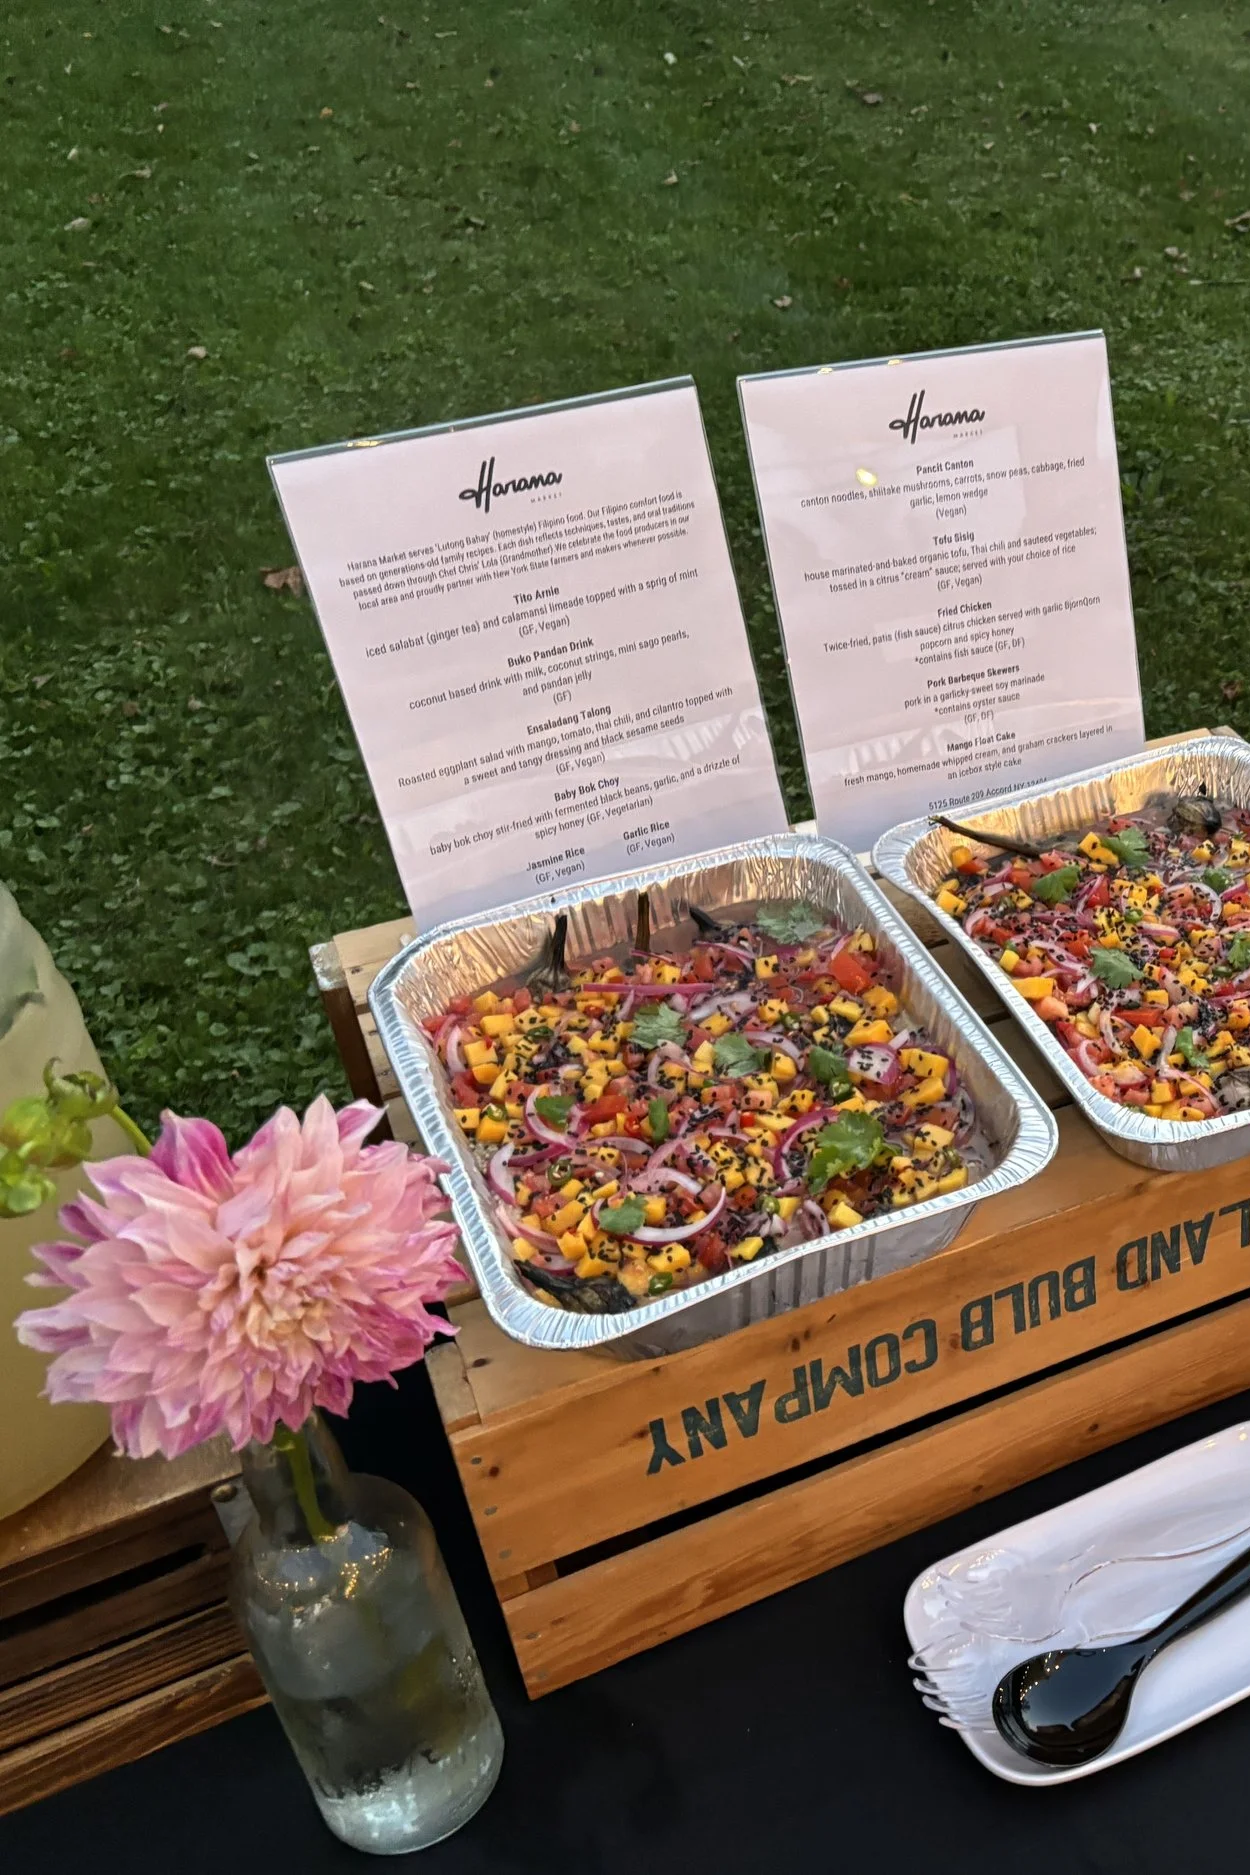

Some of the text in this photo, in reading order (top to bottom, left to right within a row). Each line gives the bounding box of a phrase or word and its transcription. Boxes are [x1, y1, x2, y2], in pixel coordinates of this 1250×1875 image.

[889, 389, 986, 444] Harana
[916, 459, 974, 476] Pancit Canton
[458, 456, 562, 514] Harana
[932, 534, 953, 546] Tofu
[804, 570, 830, 582] house
[919, 550, 950, 564] organic
[971, 543, 988, 555] Thai
[989, 540, 1006, 553] chili
[1007, 537, 1022, 550] and
[1023, 532, 1054, 547] sauteed
[513, 593, 533, 605] Tito
[937, 601, 992, 618] Fried Chicken
[365, 643, 387, 658] iced
[426, 627, 459, 646] (ginger
[461, 620, 481, 635] tea)
[482, 615, 500, 630] and
[548, 596, 585, 613] limeade
[585, 587, 617, 604] topped
[617, 583, 637, 596] with
[645, 576, 667, 590] sprig
[668, 571, 677, 584] of
[679, 568, 698, 581] mint
[537, 614, 570, 632] Vegan)
[507, 637, 594, 668] Buko Pandan Drink
[920, 627, 1015, 653] popcorn and spicy honey
[409, 692, 447, 710] coconut
[448, 682, 477, 700] based
[478, 677, 503, 692] drink
[503, 672, 523, 685] with
[547, 656, 583, 674] coconut
[618, 641, 637, 655] mini
[638, 637, 660, 650] sago
[522, 669, 592, 696] and pandan jelly
[927, 665, 1020, 689] Pork Barbeque Skewers
[553, 689, 572, 706] (GF)
[526, 705, 612, 736] Ensaladang Talong
[398, 768, 437, 788] Roasted
[438, 757, 478, 778] eggplant
[479, 748, 505, 765] salad
[505, 744, 526, 757] with
[595, 719, 612, 733] thai
[635, 707, 651, 721] and
[652, 700, 684, 716] cilantro
[685, 690, 714, 707] topped
[715, 687, 733, 699] with
[471, 767, 499, 783] sweet
[500, 761, 517, 774] and
[518, 755, 543, 769] tangy
[545, 744, 583, 762] dressing
[583, 737, 600, 751] and
[600, 731, 625, 746] black
[626, 722, 659, 739] sesame
[660, 714, 685, 729] seeds
[946, 731, 1016, 752] Mango Float Cake
[574, 751, 606, 769] Vegan)
[554, 777, 620, 803] Baby Bok Choy
[429, 842, 452, 856] baby
[453, 835, 472, 849] bok
[472, 830, 494, 843] choy
[534, 810, 554, 824] with
[554, 795, 599, 818] fermented
[599, 789, 623, 805] black
[680, 767, 695, 780] and
[703, 758, 730, 774] drizzle
[731, 753, 740, 765] of
[534, 825, 557, 840] spicy
[558, 817, 585, 832] honey
[623, 821, 670, 841] Garlic Rice
[644, 832, 675, 848] Vegan)
[526, 847, 585, 872] Jasmine Rice
[554, 860, 585, 878] Vegan)
[961, 1256, 1097, 1352] BULB
